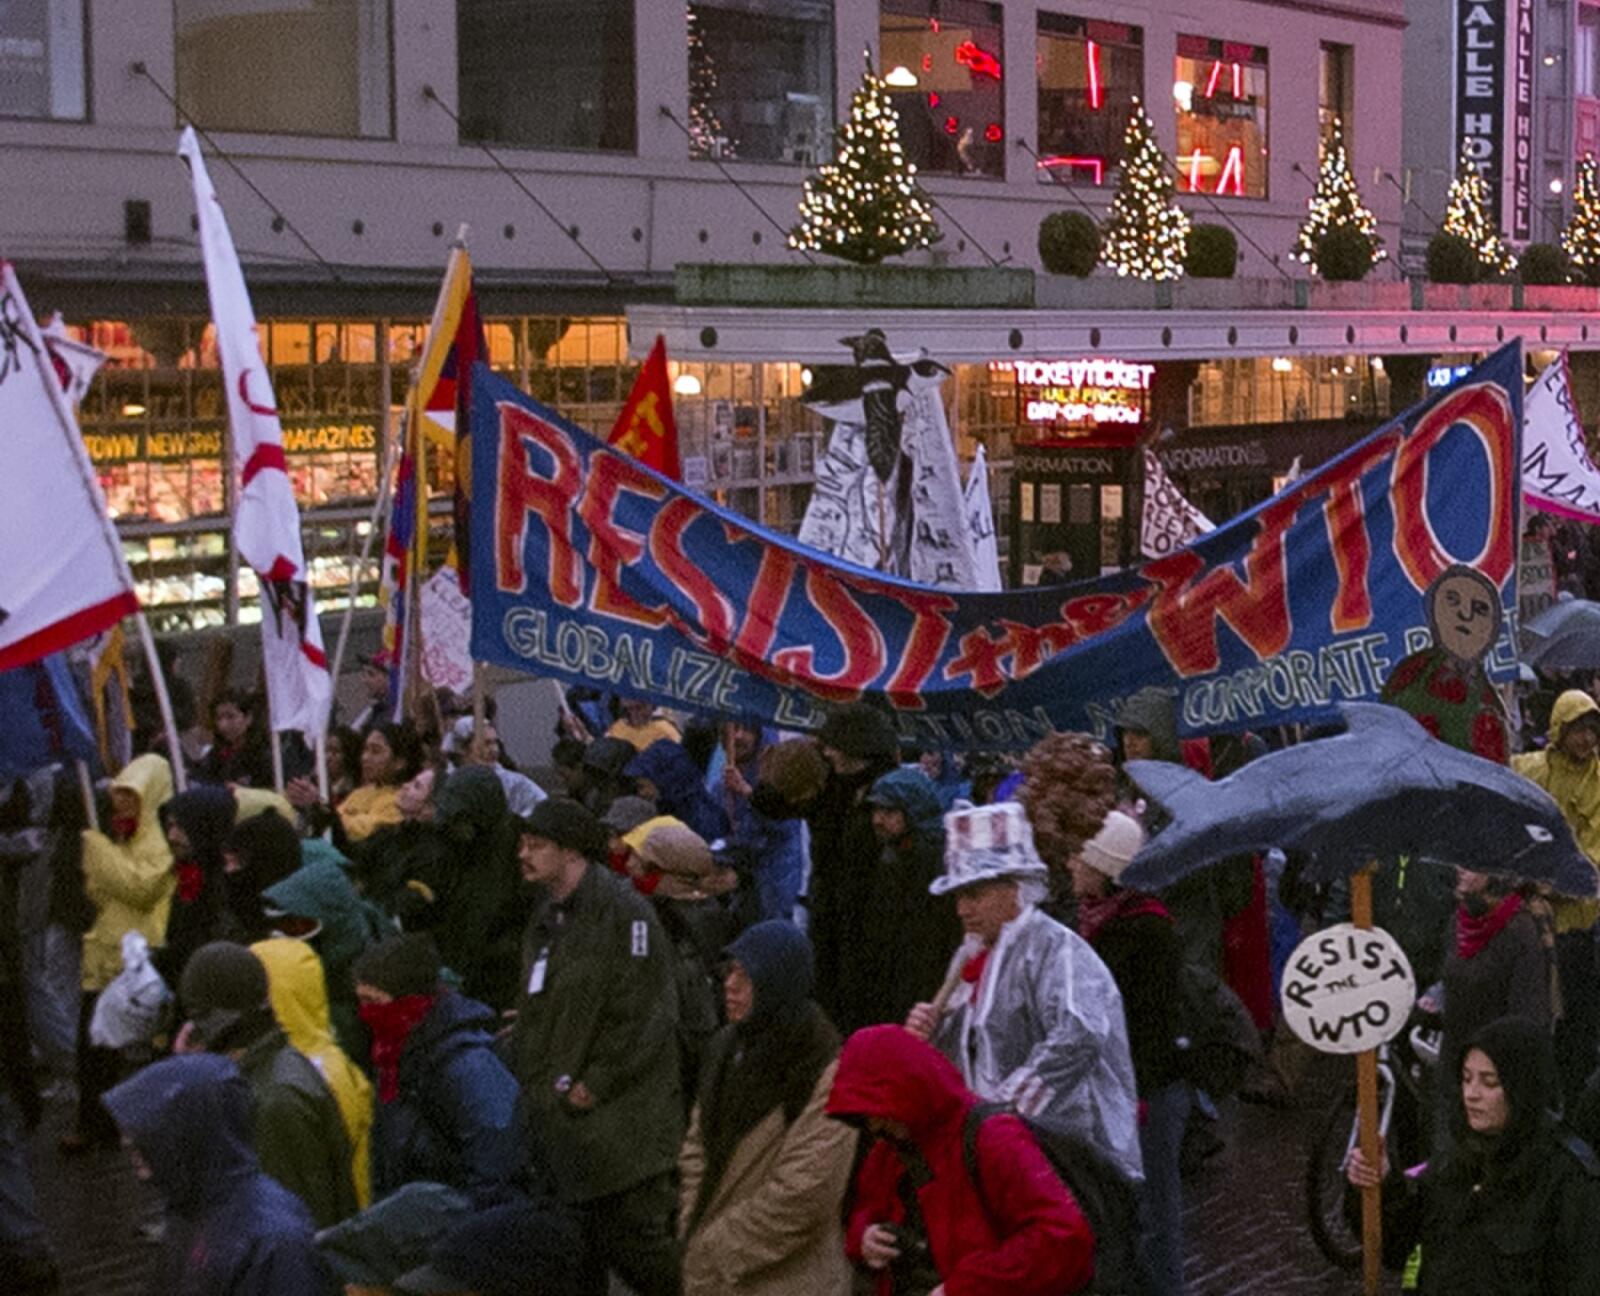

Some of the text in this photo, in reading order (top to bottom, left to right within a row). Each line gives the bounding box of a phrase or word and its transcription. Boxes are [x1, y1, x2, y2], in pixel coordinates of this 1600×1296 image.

[1516, 116, 1529, 230] HOTEL
[496, 401, 959, 712] RESIST
[1139, 380, 1517, 679] WTO
[503, 607, 751, 711] GLOBALIZE
[1183, 632, 1392, 728] CORPORATE
[1285, 935, 1407, 1009] RESIST
[1324, 974, 1359, 993] THE
[1308, 1000, 1390, 1043] WTO
